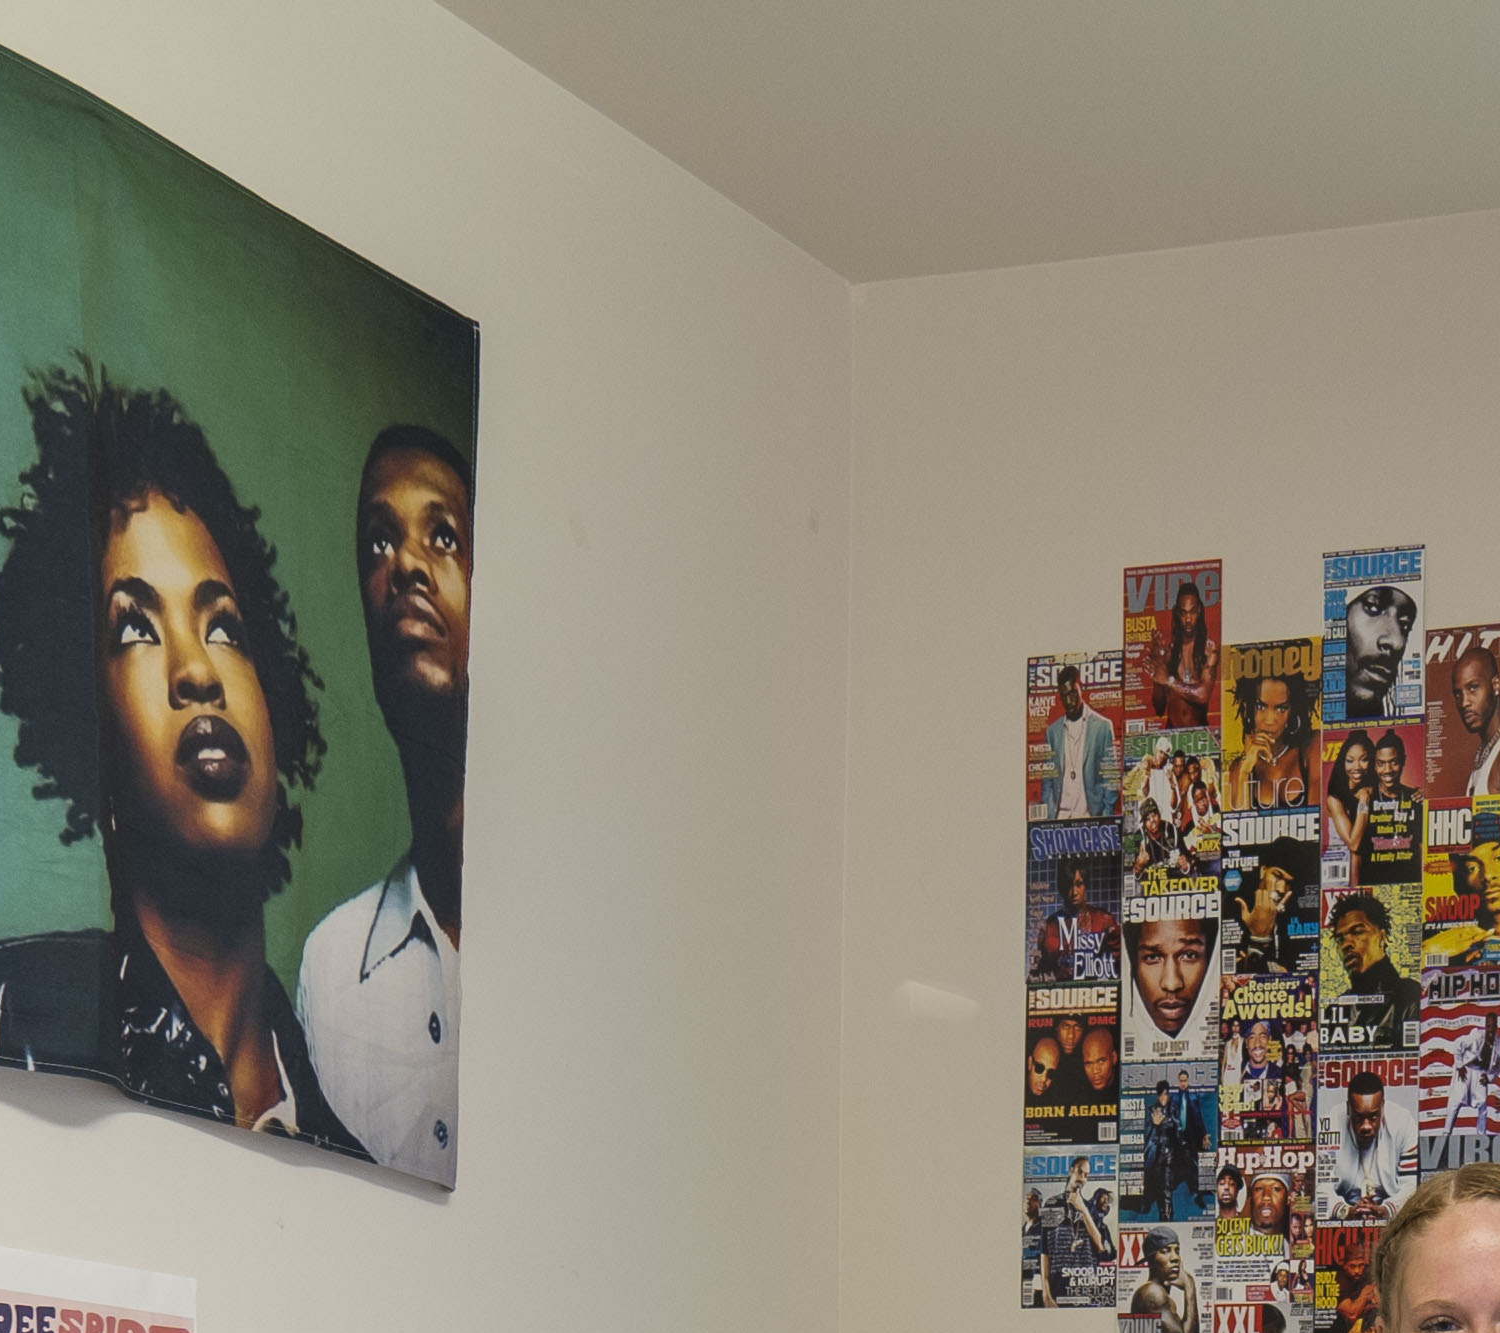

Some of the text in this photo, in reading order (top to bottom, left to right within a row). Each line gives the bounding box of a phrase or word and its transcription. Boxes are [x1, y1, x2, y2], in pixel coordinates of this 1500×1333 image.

[1333, 551, 1422, 582] SOURCE
[1125, 616, 1157, 633] BUSTA
[1036, 659, 1122, 688] SORCE
[1028, 696, 1056, 710] KANYE
[1029, 706, 1051, 717] WEST
[1223, 812, 1319, 848] SOURCE
[1427, 807, 1473, 848] HHC
[1030, 825, 1121, 862] SHOWCASE
[1197, 839, 1220, 853] DMX
[1222, 856, 1260, 869] FUTURE
[1147, 867, 1168, 880] THE
[1140, 876, 1219, 896] TAKEOVER
[1130, 894, 1220, 922] SOURCE
[1425, 895, 1481, 921] SNOOP
[1058, 916, 1106, 953] Missy
[1287, 922, 1319, 938] BABY
[1073, 951, 1119, 981] Elliott
[1248, 978, 1300, 992] Readers'
[1428, 974, 1467, 1001] HIP
[1035, 986, 1118, 1010] SOURCE
[1234, 984, 1288, 1004] Choice
[1222, 995, 1313, 1021] Awards!
[1320, 1007, 1349, 1025] LIL
[1028, 1016, 1117, 1028] RUN DMC
[1319, 1026, 1378, 1045] BABY
[1025, 1104, 1118, 1118] BORN AGAIN
[1319, 1118, 1331, 1132] YO
[1318, 1132, 1341, 1146] GOTTI
[1032, 1154, 1117, 1177] SOUCE
[1263, 1146, 1316, 1174] Hop
[1232, 1217, 1251, 1233] CENT
[1216, 1233, 1285, 1257] GETS BUCK!!
[1096, 1266, 1116, 1277] DAZ
[1315, 1270, 1337, 1282] BUDZ
[1077, 1277, 1117, 1287] KURUPT
[1315, 1283, 1340, 1296] IN THE
[1065, 1286, 1117, 1296] THE RETURN
[1315, 1295, 1338, 1310] HOOD
